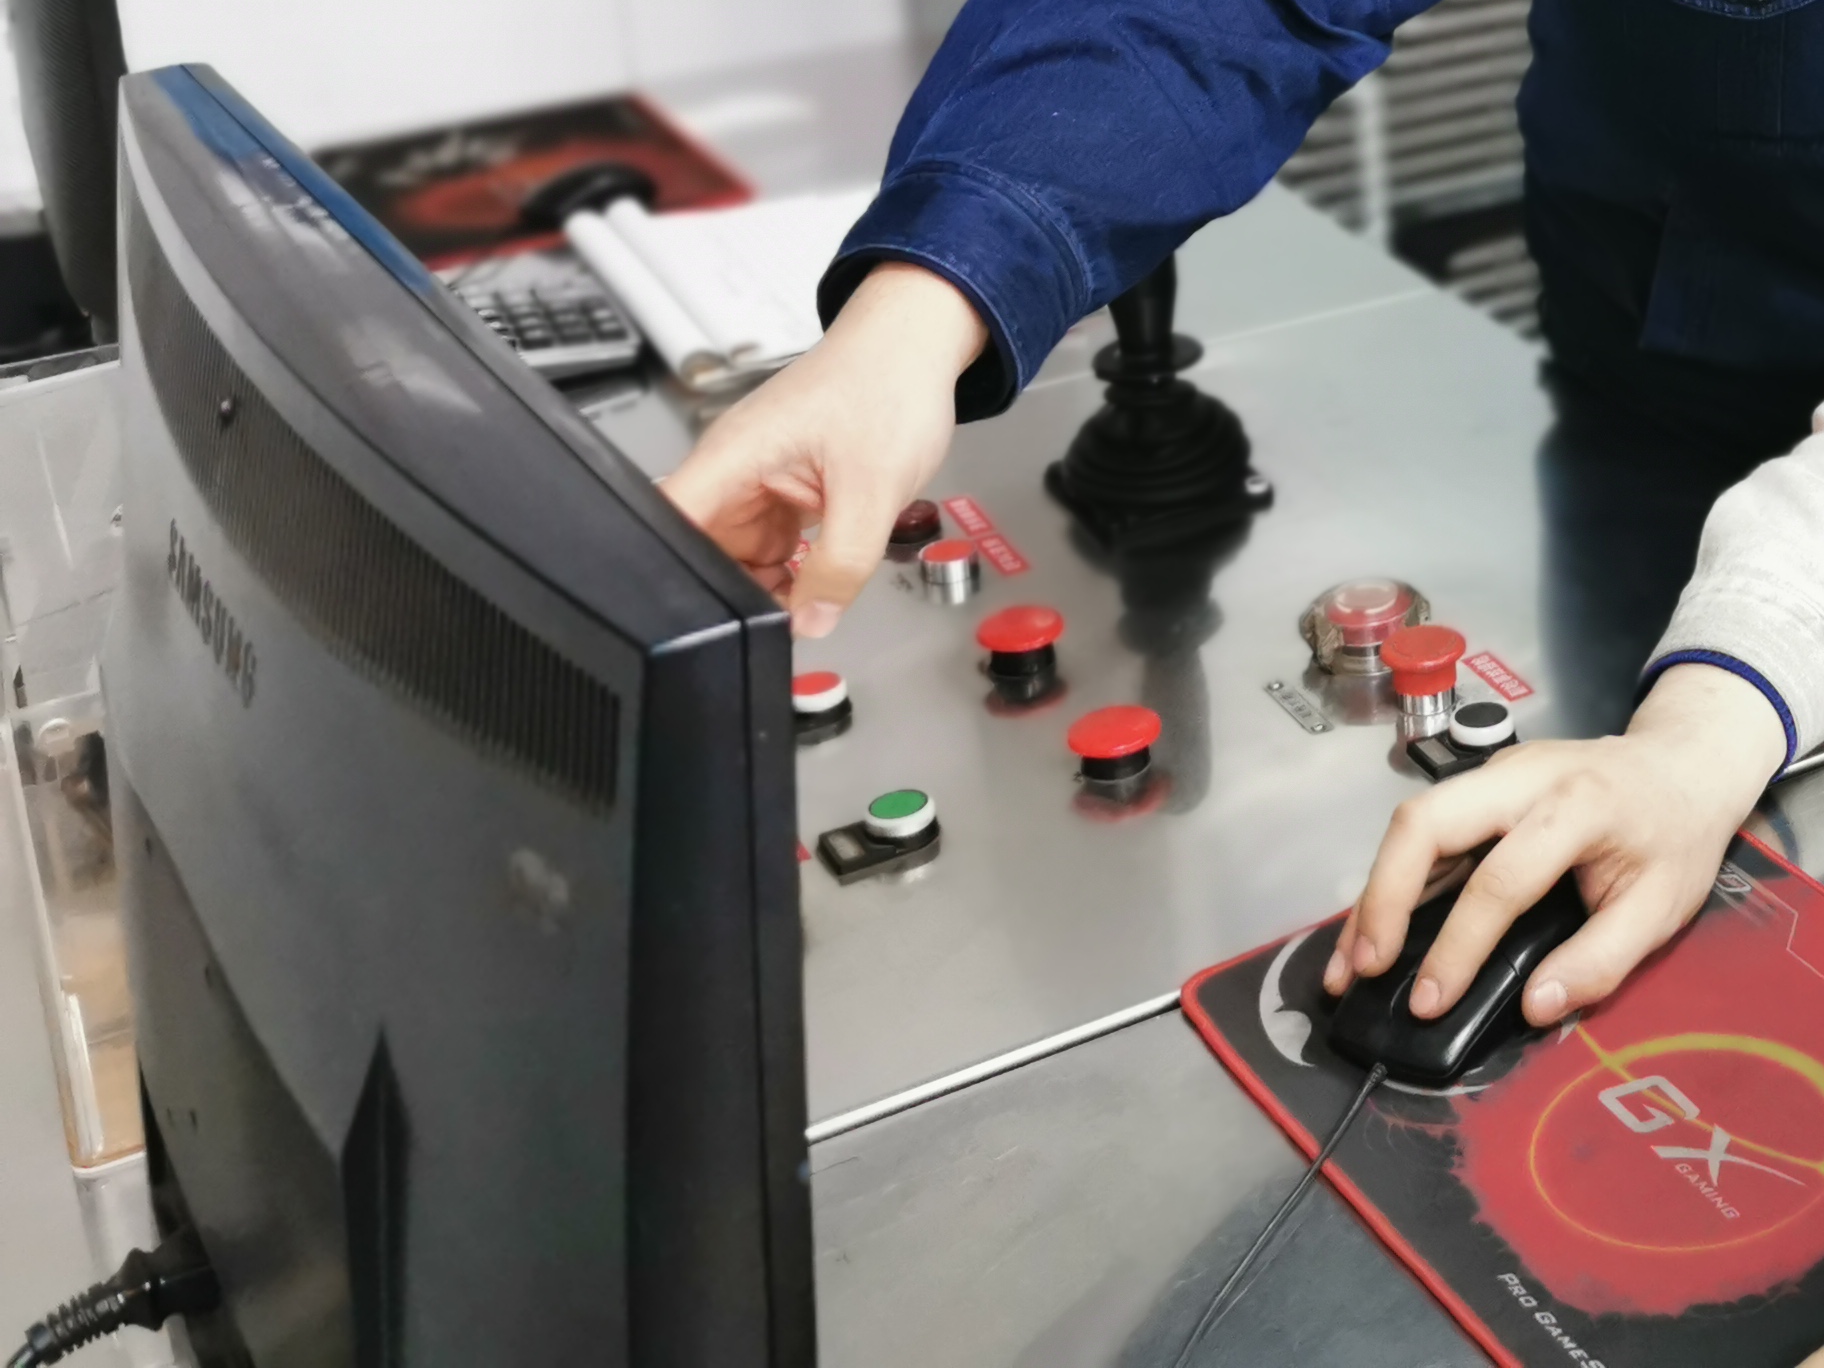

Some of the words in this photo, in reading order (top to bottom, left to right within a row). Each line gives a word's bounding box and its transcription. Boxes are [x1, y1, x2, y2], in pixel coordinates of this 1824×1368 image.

[167, 517, 258, 710] SAMSUNG
[1598, 1075, 1807, 1187] GX
[1674, 1162, 1741, 1220] GAMING
[1496, 1272, 1539, 1308] PRO
